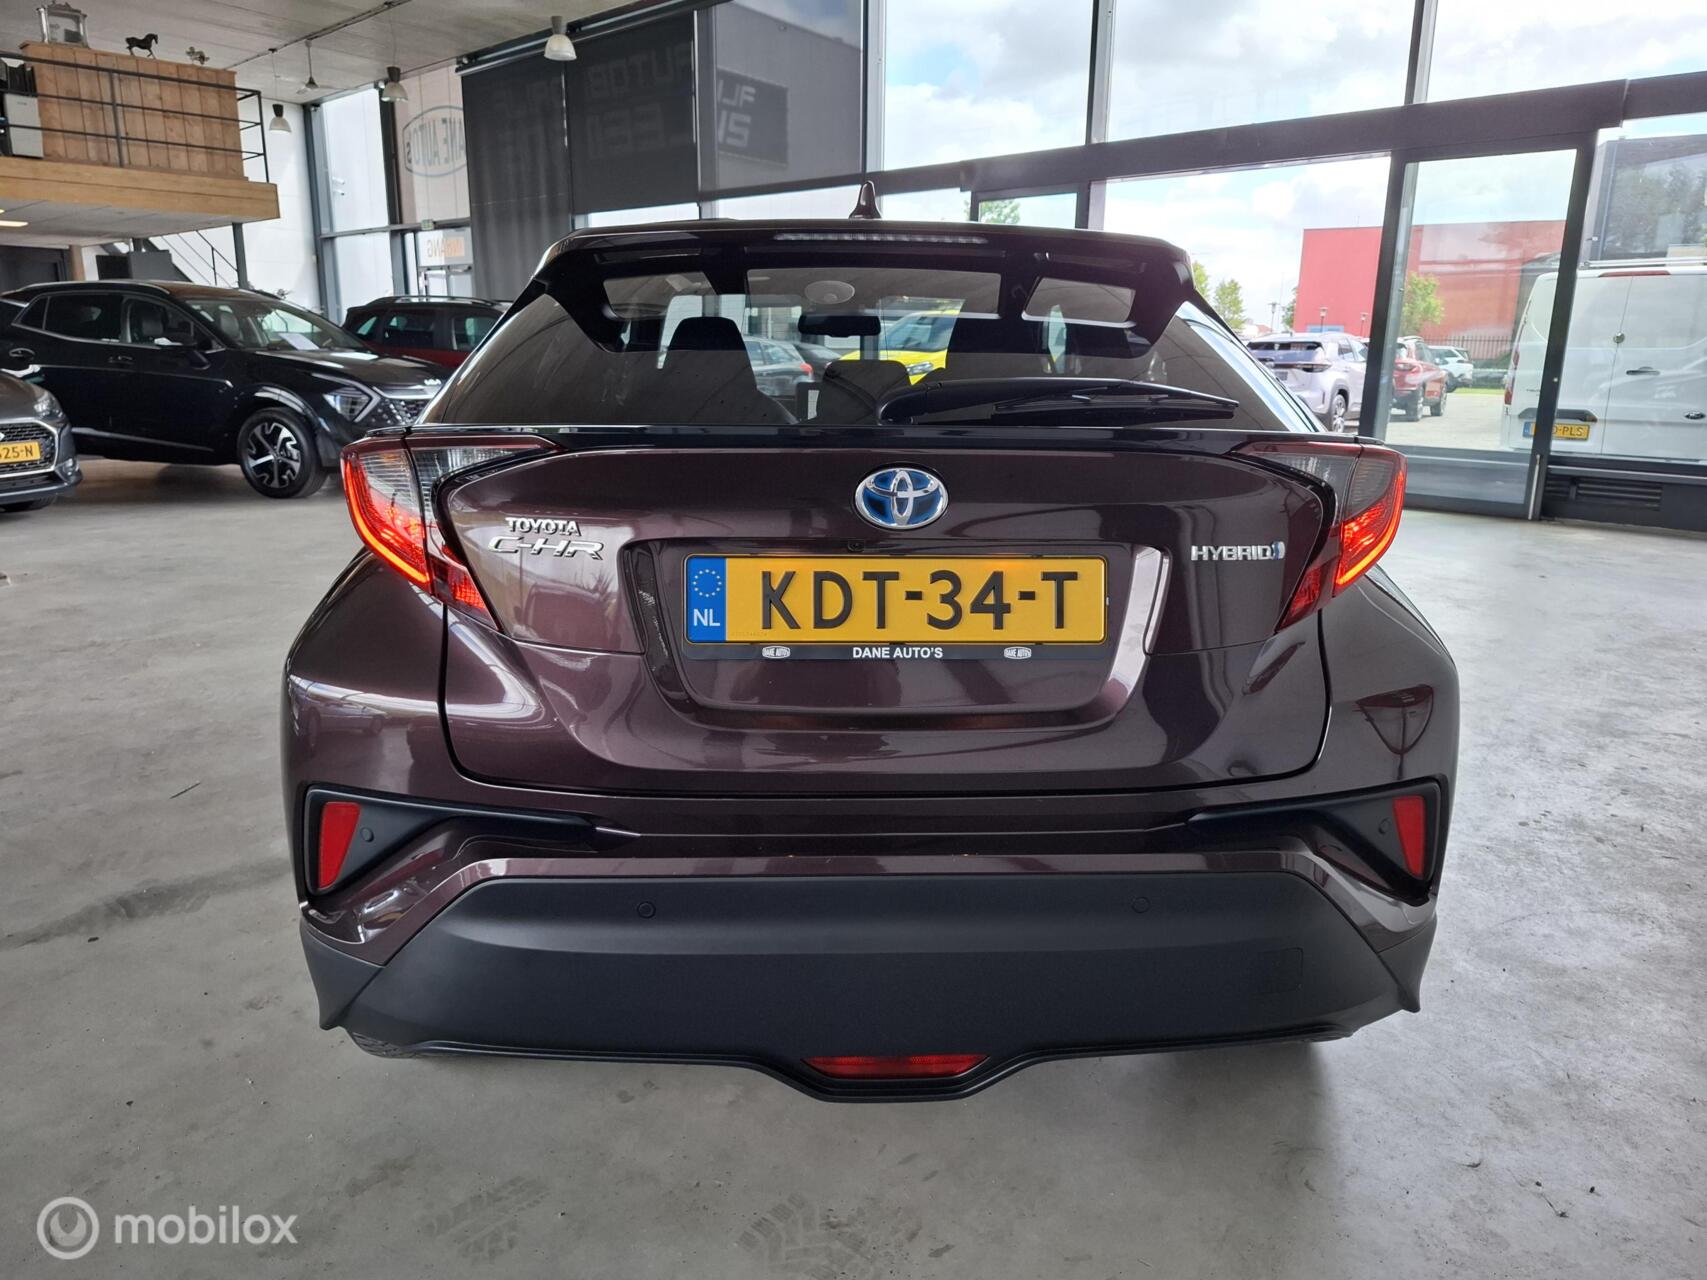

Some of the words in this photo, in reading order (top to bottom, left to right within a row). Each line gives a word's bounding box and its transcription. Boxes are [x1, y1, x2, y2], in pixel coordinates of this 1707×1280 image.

[0, 444, 34, 460] 25-N
[505, 517, 582, 536] TOYOTA
[488, 536, 604, 560] C-HR
[1191, 545, 1272, 561] HYBRID
[761, 569, 1079, 630] KDT-34-T
[693, 608, 721, 627] NL
[852, 647, 890, 658] DANE
[893, 647, 943, 658] AUTO'S
